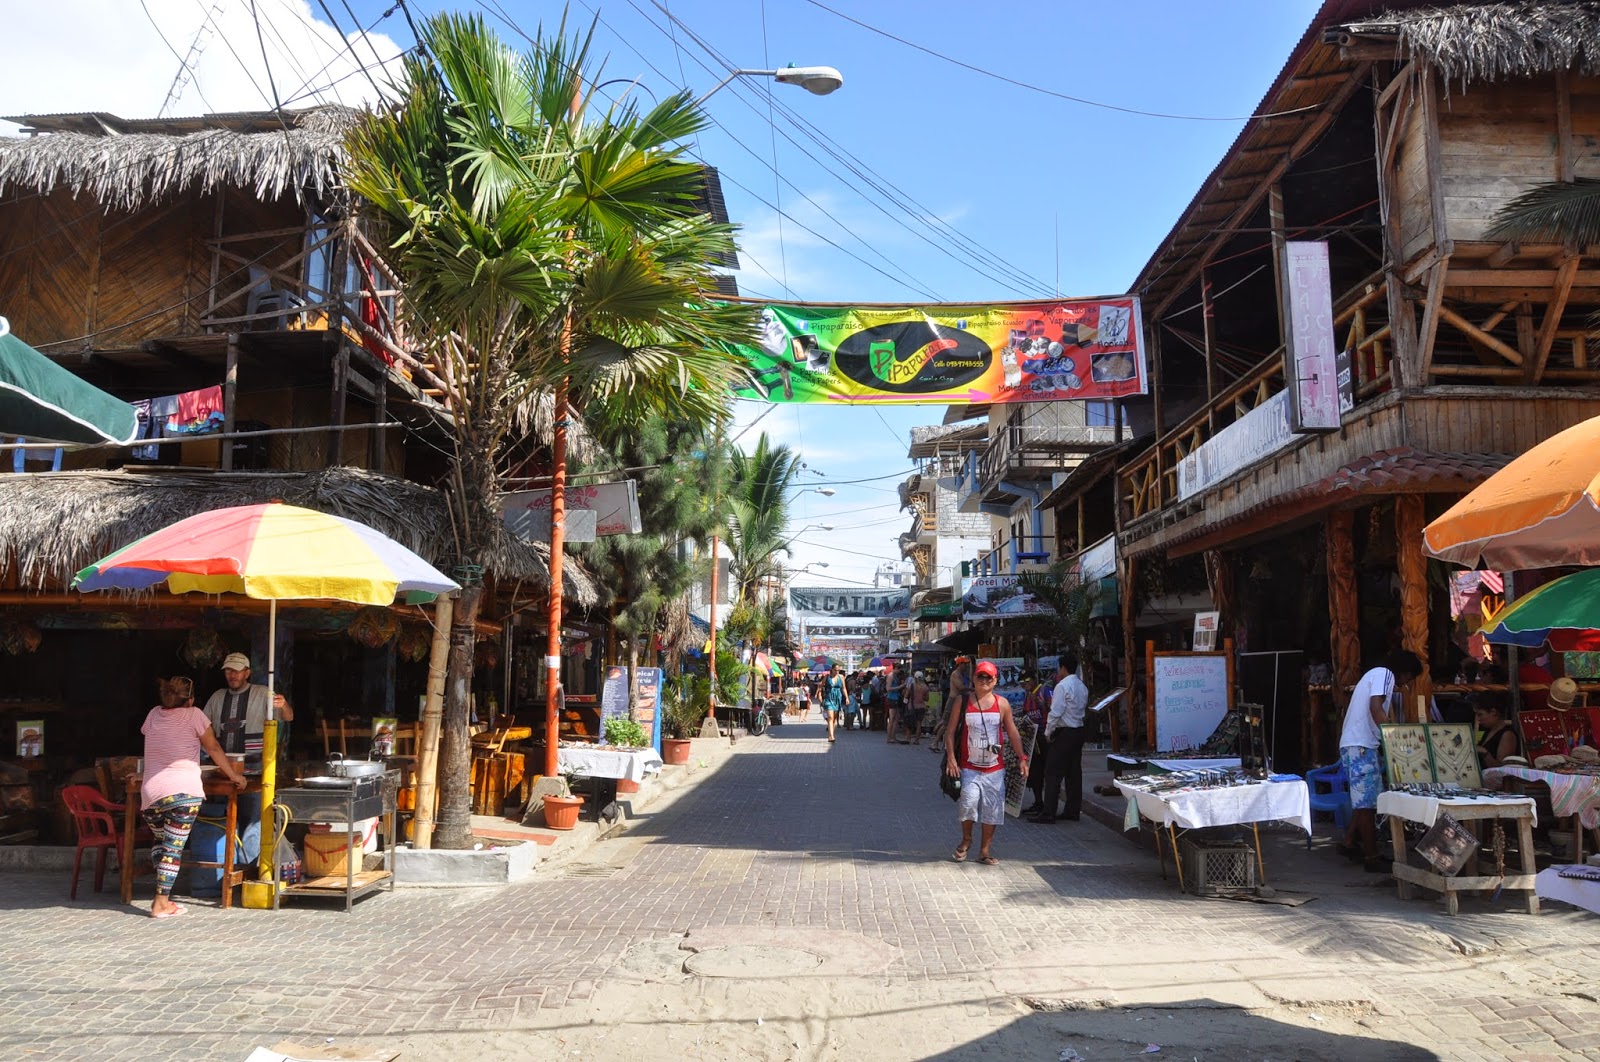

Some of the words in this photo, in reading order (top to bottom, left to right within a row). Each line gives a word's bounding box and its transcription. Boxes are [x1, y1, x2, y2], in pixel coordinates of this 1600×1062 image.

[1041, 304, 1097, 317] Vaporadores
[1097, 337, 1134, 349] Hookahs
[817, 377, 841, 387] Papers
[997, 382, 1043, 393] Moledores
[1021, 391, 1058, 400] Grinders
[526, 494, 591, 509] TROCAL
[971, 578, 997, 587] Hotel
[796, 595, 905, 612] ALCATRAZ
[817, 627, 879, 635] TATTOO
[1444, 814, 1458, 829] DUCK
[1456, 825, 1478, 846] DYNASTY
